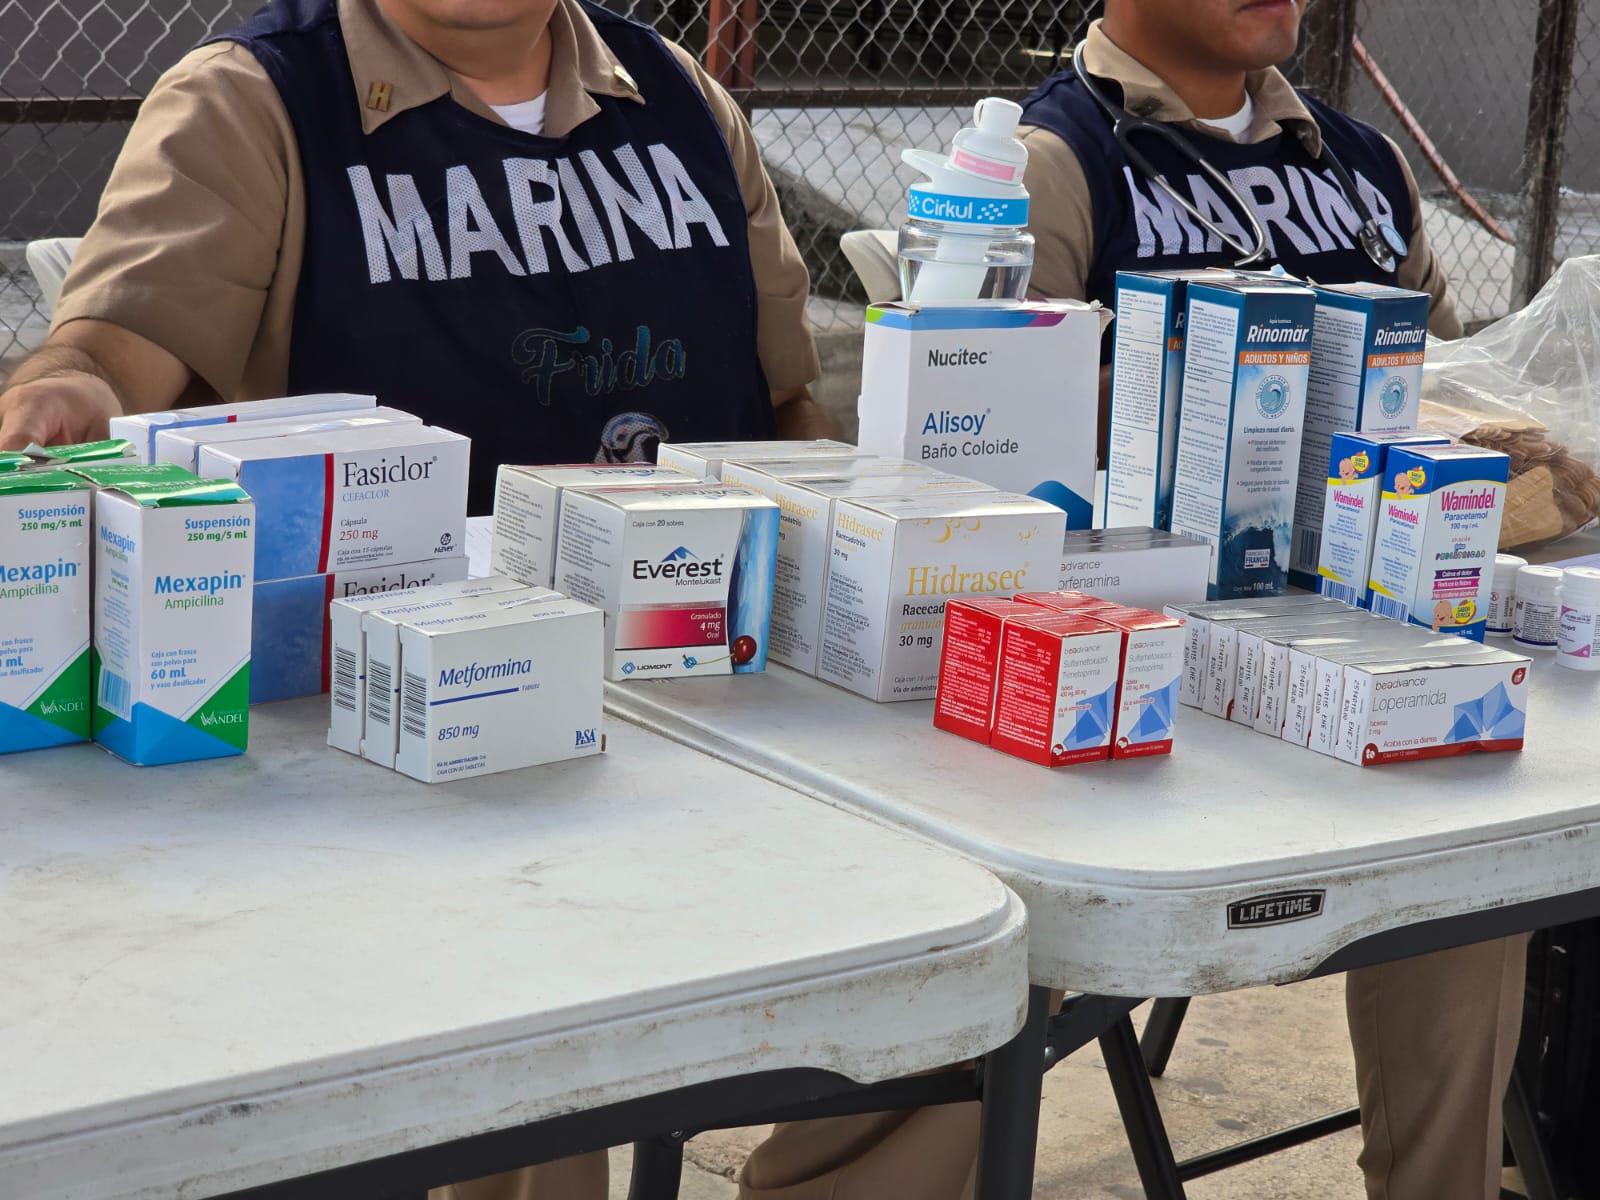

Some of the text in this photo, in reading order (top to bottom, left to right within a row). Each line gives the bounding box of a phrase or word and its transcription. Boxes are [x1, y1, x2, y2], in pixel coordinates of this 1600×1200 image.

[346, 142, 730, 284] MARINA
[922, 198, 973, 219] Cirkul
[1122, 164, 1399, 258] MARINA
[512, 325, 686, 406] Frida
[928, 348, 988, 367] Nucitec
[1245, 352, 1309, 364] ADULTOS Y NIÑOS
[1372, 354, 1424, 366] ADULTOS Y NIÑOS
[922, 411, 986, 435] Alisoy
[922, 439, 1019, 460] Baño Coloide
[344, 456, 433, 487] Fasiclor
[342, 489, 390, 502] CEFACLOR
[1334, 490, 1364, 508] Wamindel
[1441, 488, 1496, 511] Wamindel
[18, 504, 85, 520] Suspensión
[1388, 504, 1418, 524] Wamindel
[1444, 511, 1488, 521] Paracetamol
[21, 521, 38, 531] 250
[41, 519, 67, 531] mg/5
[185, 516, 250, 531] Suspensión
[340, 517, 367, 527] Cápsula
[657, 519, 665, 527] 20
[838, 512, 883, 542] Hidrasec
[101, 526, 135, 552] Mexapin
[187, 533, 204, 541] 250
[206, 531, 232, 542] mg/5
[339, 529, 378, 541] 250 mg
[633, 558, 722, 579] Everest
[1060, 561, 1100, 572] advance
[155, 570, 241, 595] Mexapin
[675, 577, 721, 586] Montelukast
[905, 564, 1027, 597] Hidrasec
[1058, 574, 1120, 590] orfenamina
[1253, 582, 1264, 591] 100
[0, 583, 59, 600] Ampicilina
[165, 595, 224, 611] Ampicilina
[902, 602, 945, 616] Racecad
[414, 613, 486, 628] Metformina
[691, 612, 722, 620] Granulado
[700, 621, 720, 631] 4 mg
[706, 631, 720, 639] Oral
[899, 635, 932, 648] 30 mg
[151, 668, 165, 680] 60
[438, 659, 532, 688] Metformina
[637, 663, 672, 671] LIOMONT
[1372, 689, 1446, 713] Loperamida
[438, 724, 480, 741] 850 mg
[1240, 897, 1312, 921] LIFETIME
